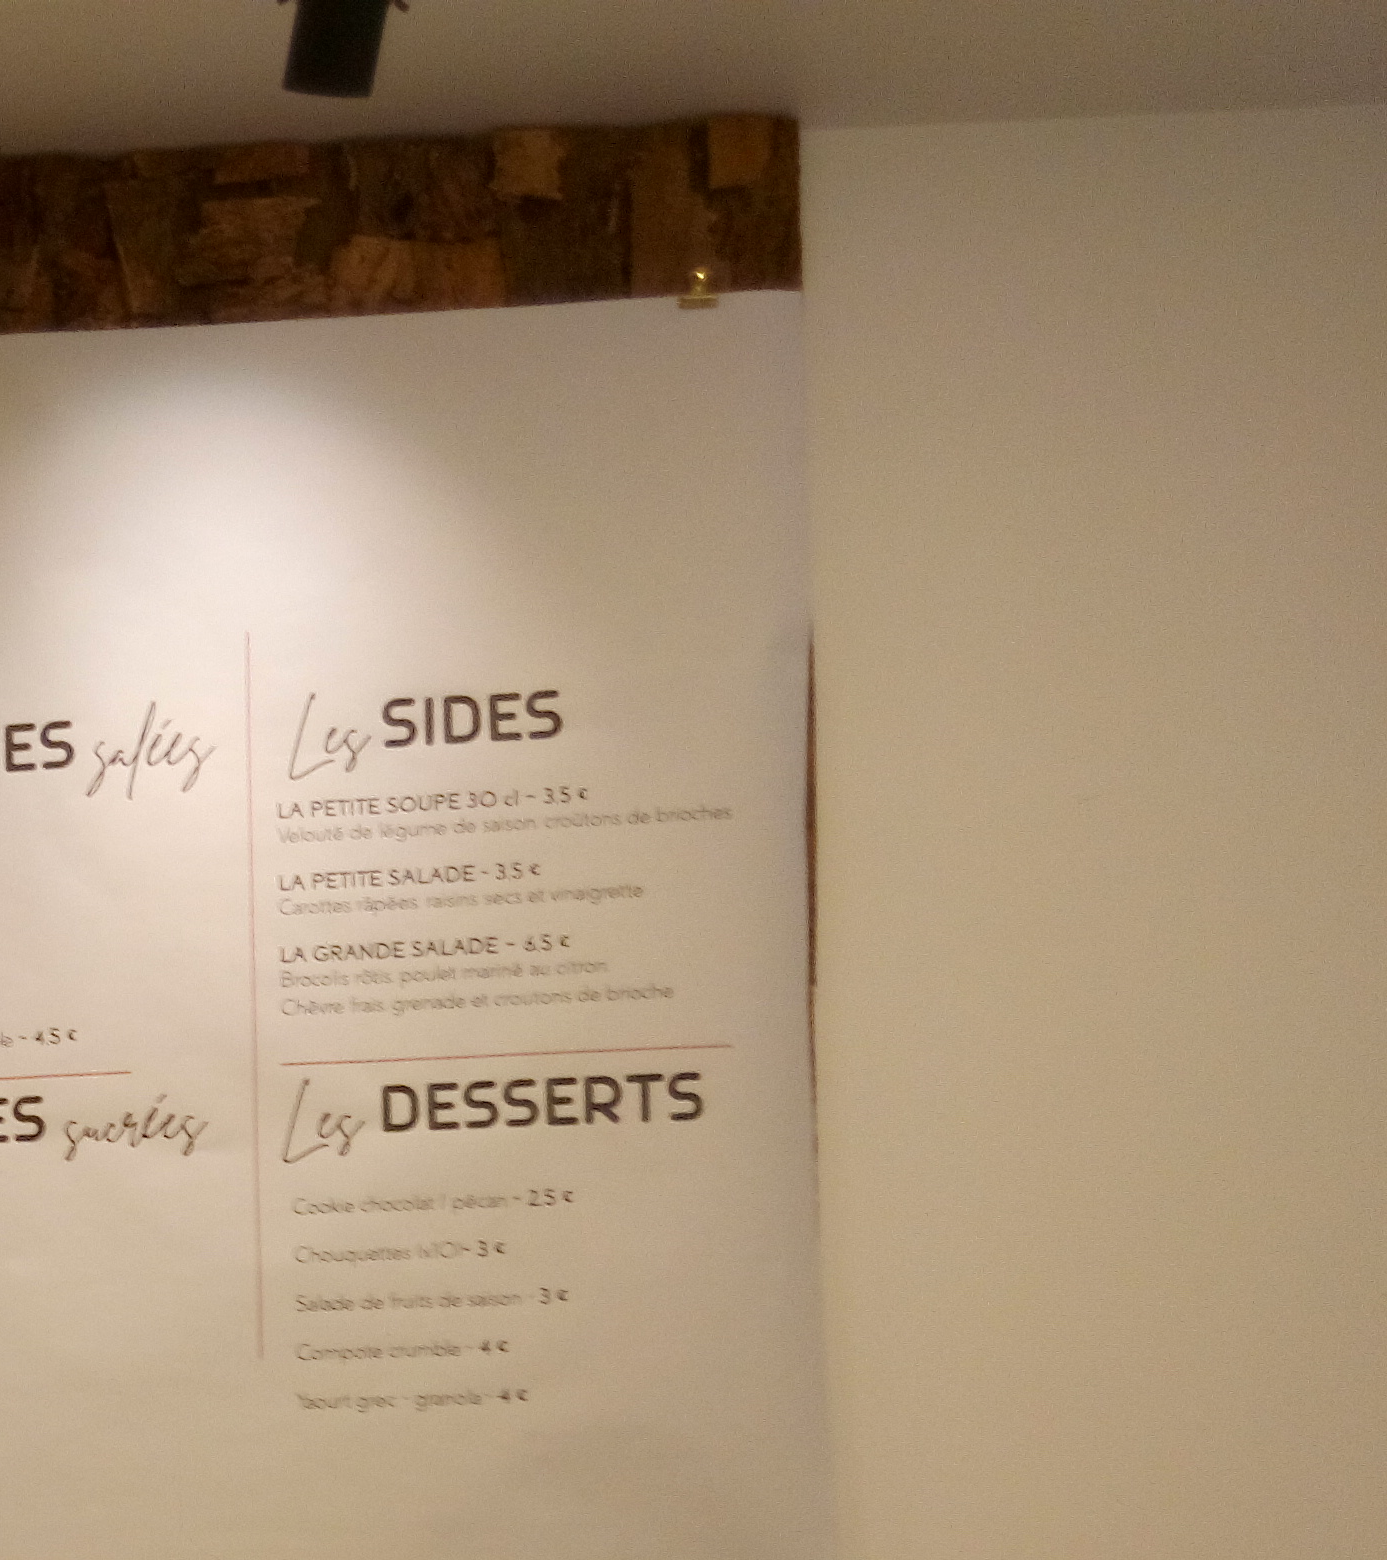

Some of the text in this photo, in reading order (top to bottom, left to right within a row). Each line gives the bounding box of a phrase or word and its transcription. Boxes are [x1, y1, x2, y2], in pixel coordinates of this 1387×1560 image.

[85, 700, 217, 799] salées
[288, 690, 563, 781] Les SIDES
[277, 801, 304, 820] LA
[310, 797, 380, 818] PETITE
[385, 793, 461, 814] SOUPE
[277, 865, 475, 892] LA PETITE SALADE
[279, 937, 499, 965] LA GRANDE SALADE
[64, 1093, 208, 1162] sucrées
[282, 1072, 705, 1164] Les DESSERTS
[476, 1240, 488, 1258] 3
[538, 1287, 551, 1305] 3
